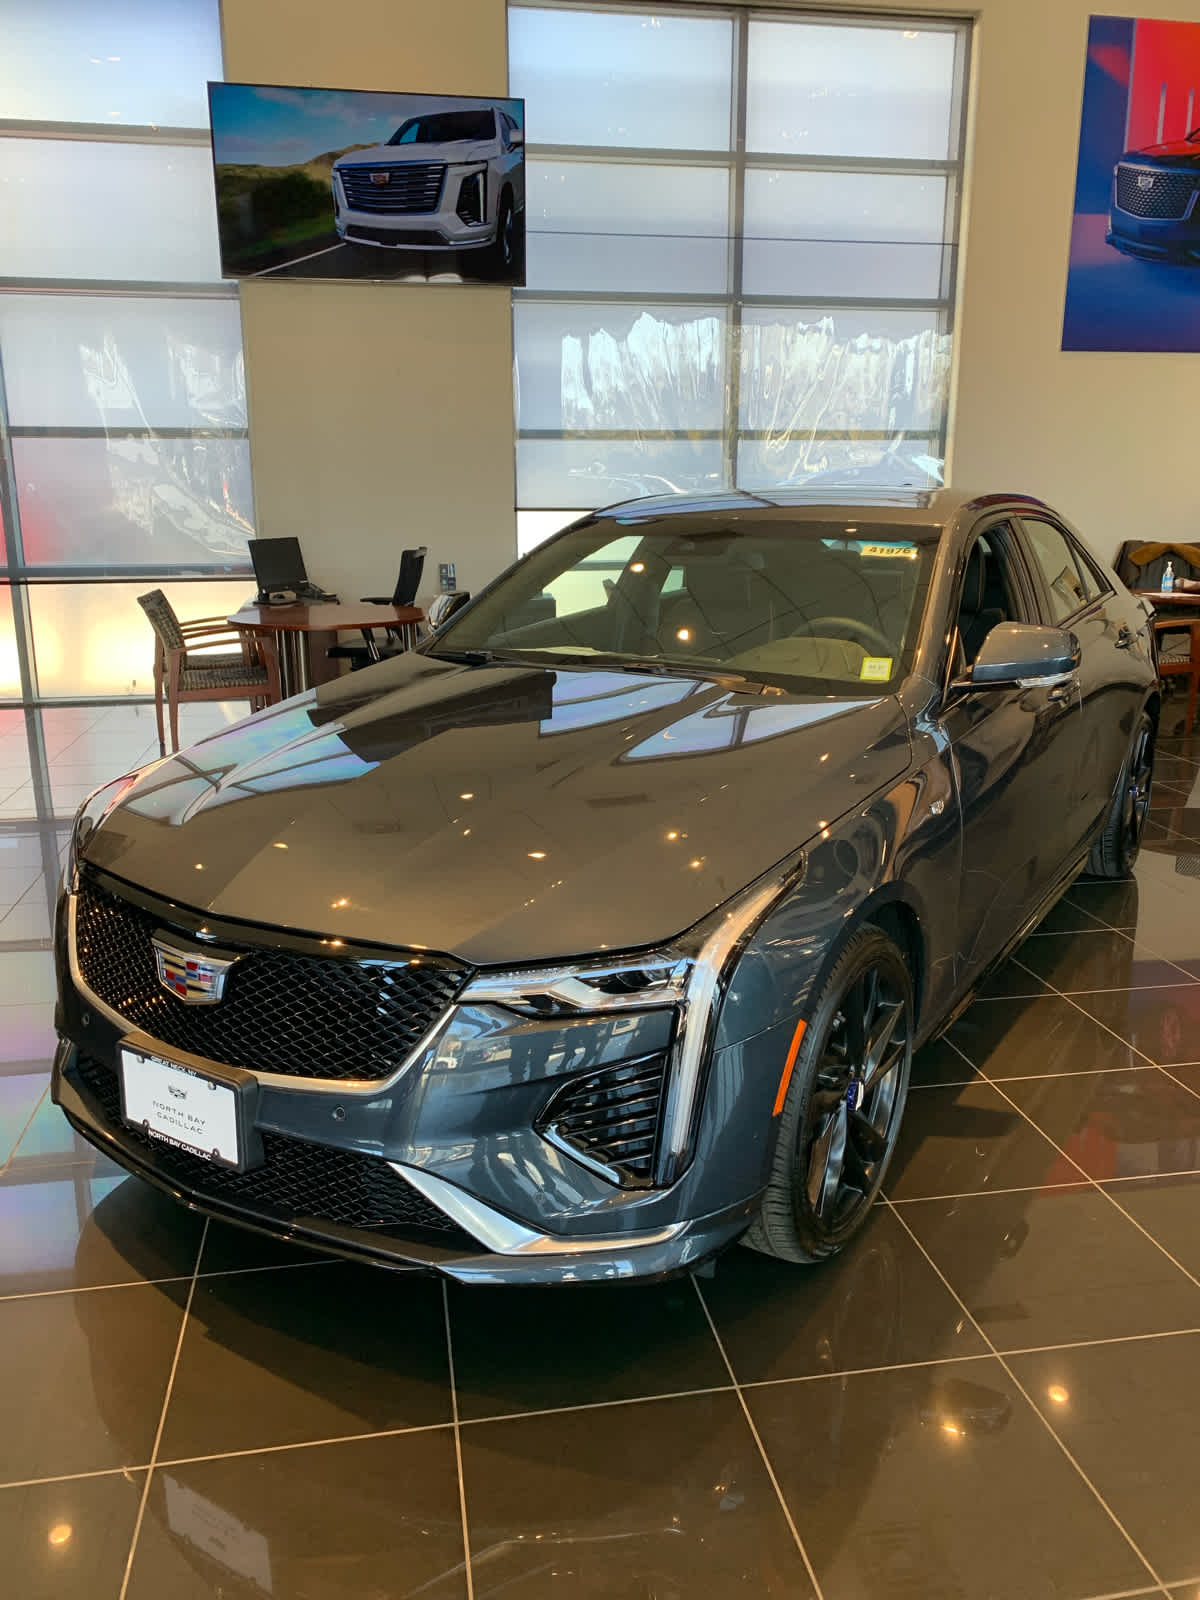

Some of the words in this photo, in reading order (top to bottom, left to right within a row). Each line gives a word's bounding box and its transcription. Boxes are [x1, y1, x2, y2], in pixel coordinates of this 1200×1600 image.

[152, 1100, 184, 1116] NORTH
[187, 1114, 205, 1125] BAY
[157, 1112, 203, 1134] CADILLAC
[148, 1129, 169, 1143] NORTH
[169, 1138, 181, 1148] BAY
[181, 1144, 212, 1161] CADILLAC
